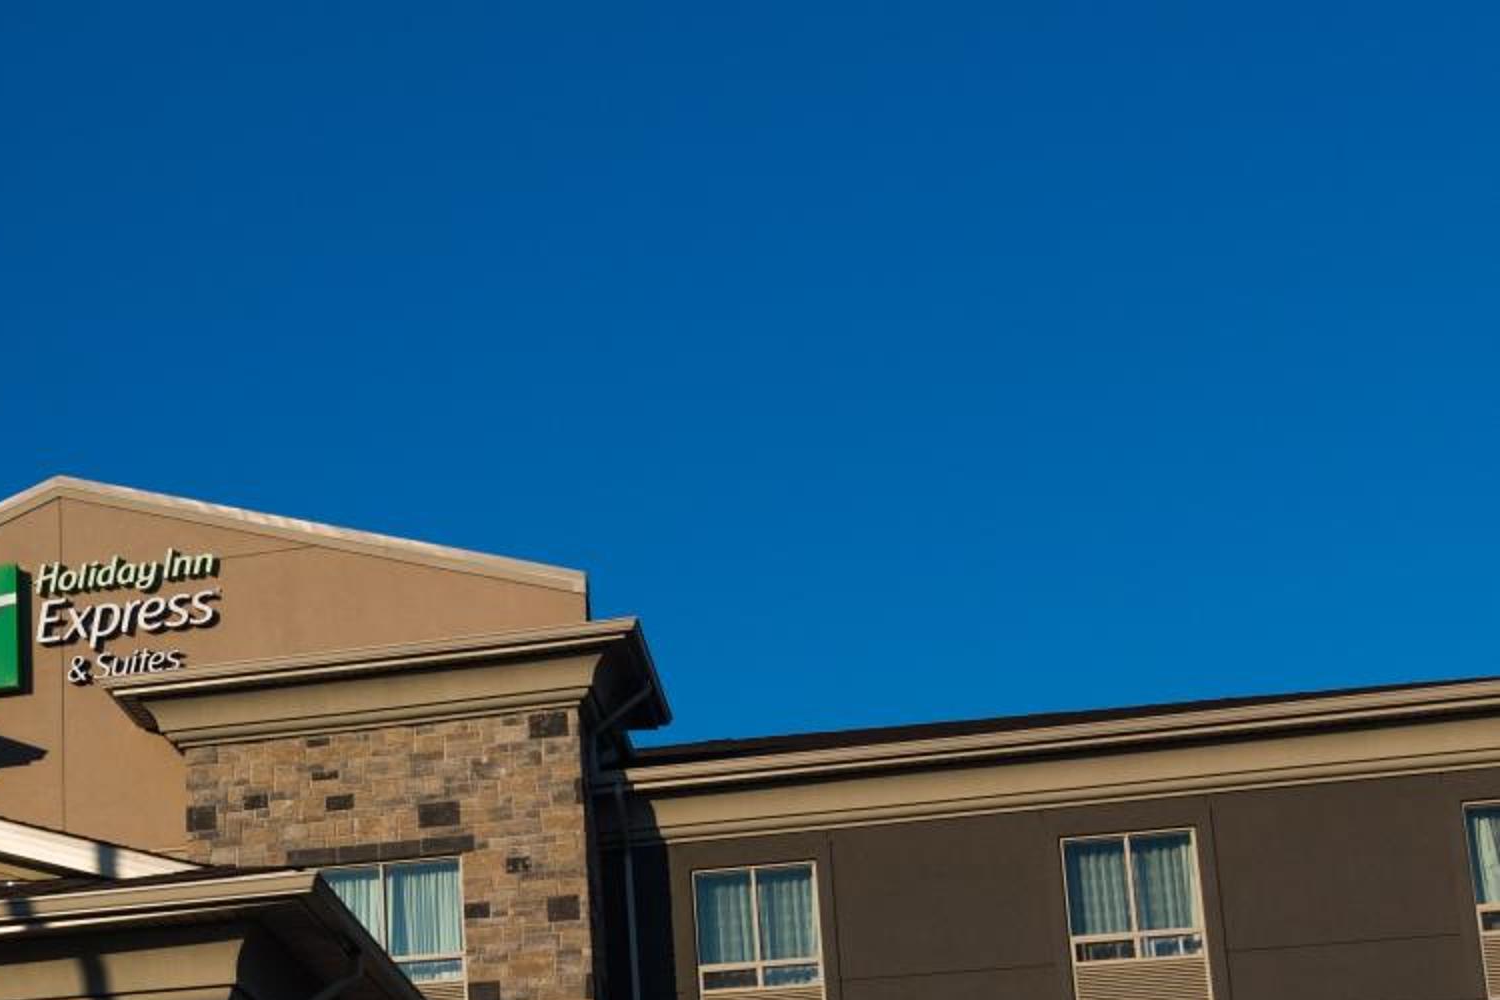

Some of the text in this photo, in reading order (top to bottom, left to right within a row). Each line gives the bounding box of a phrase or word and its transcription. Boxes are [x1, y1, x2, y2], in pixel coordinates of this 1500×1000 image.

[35, 548, 214, 595] Holiday Inn
[36, 589, 219, 648] Express
[67, 648, 181, 682] & Suites
